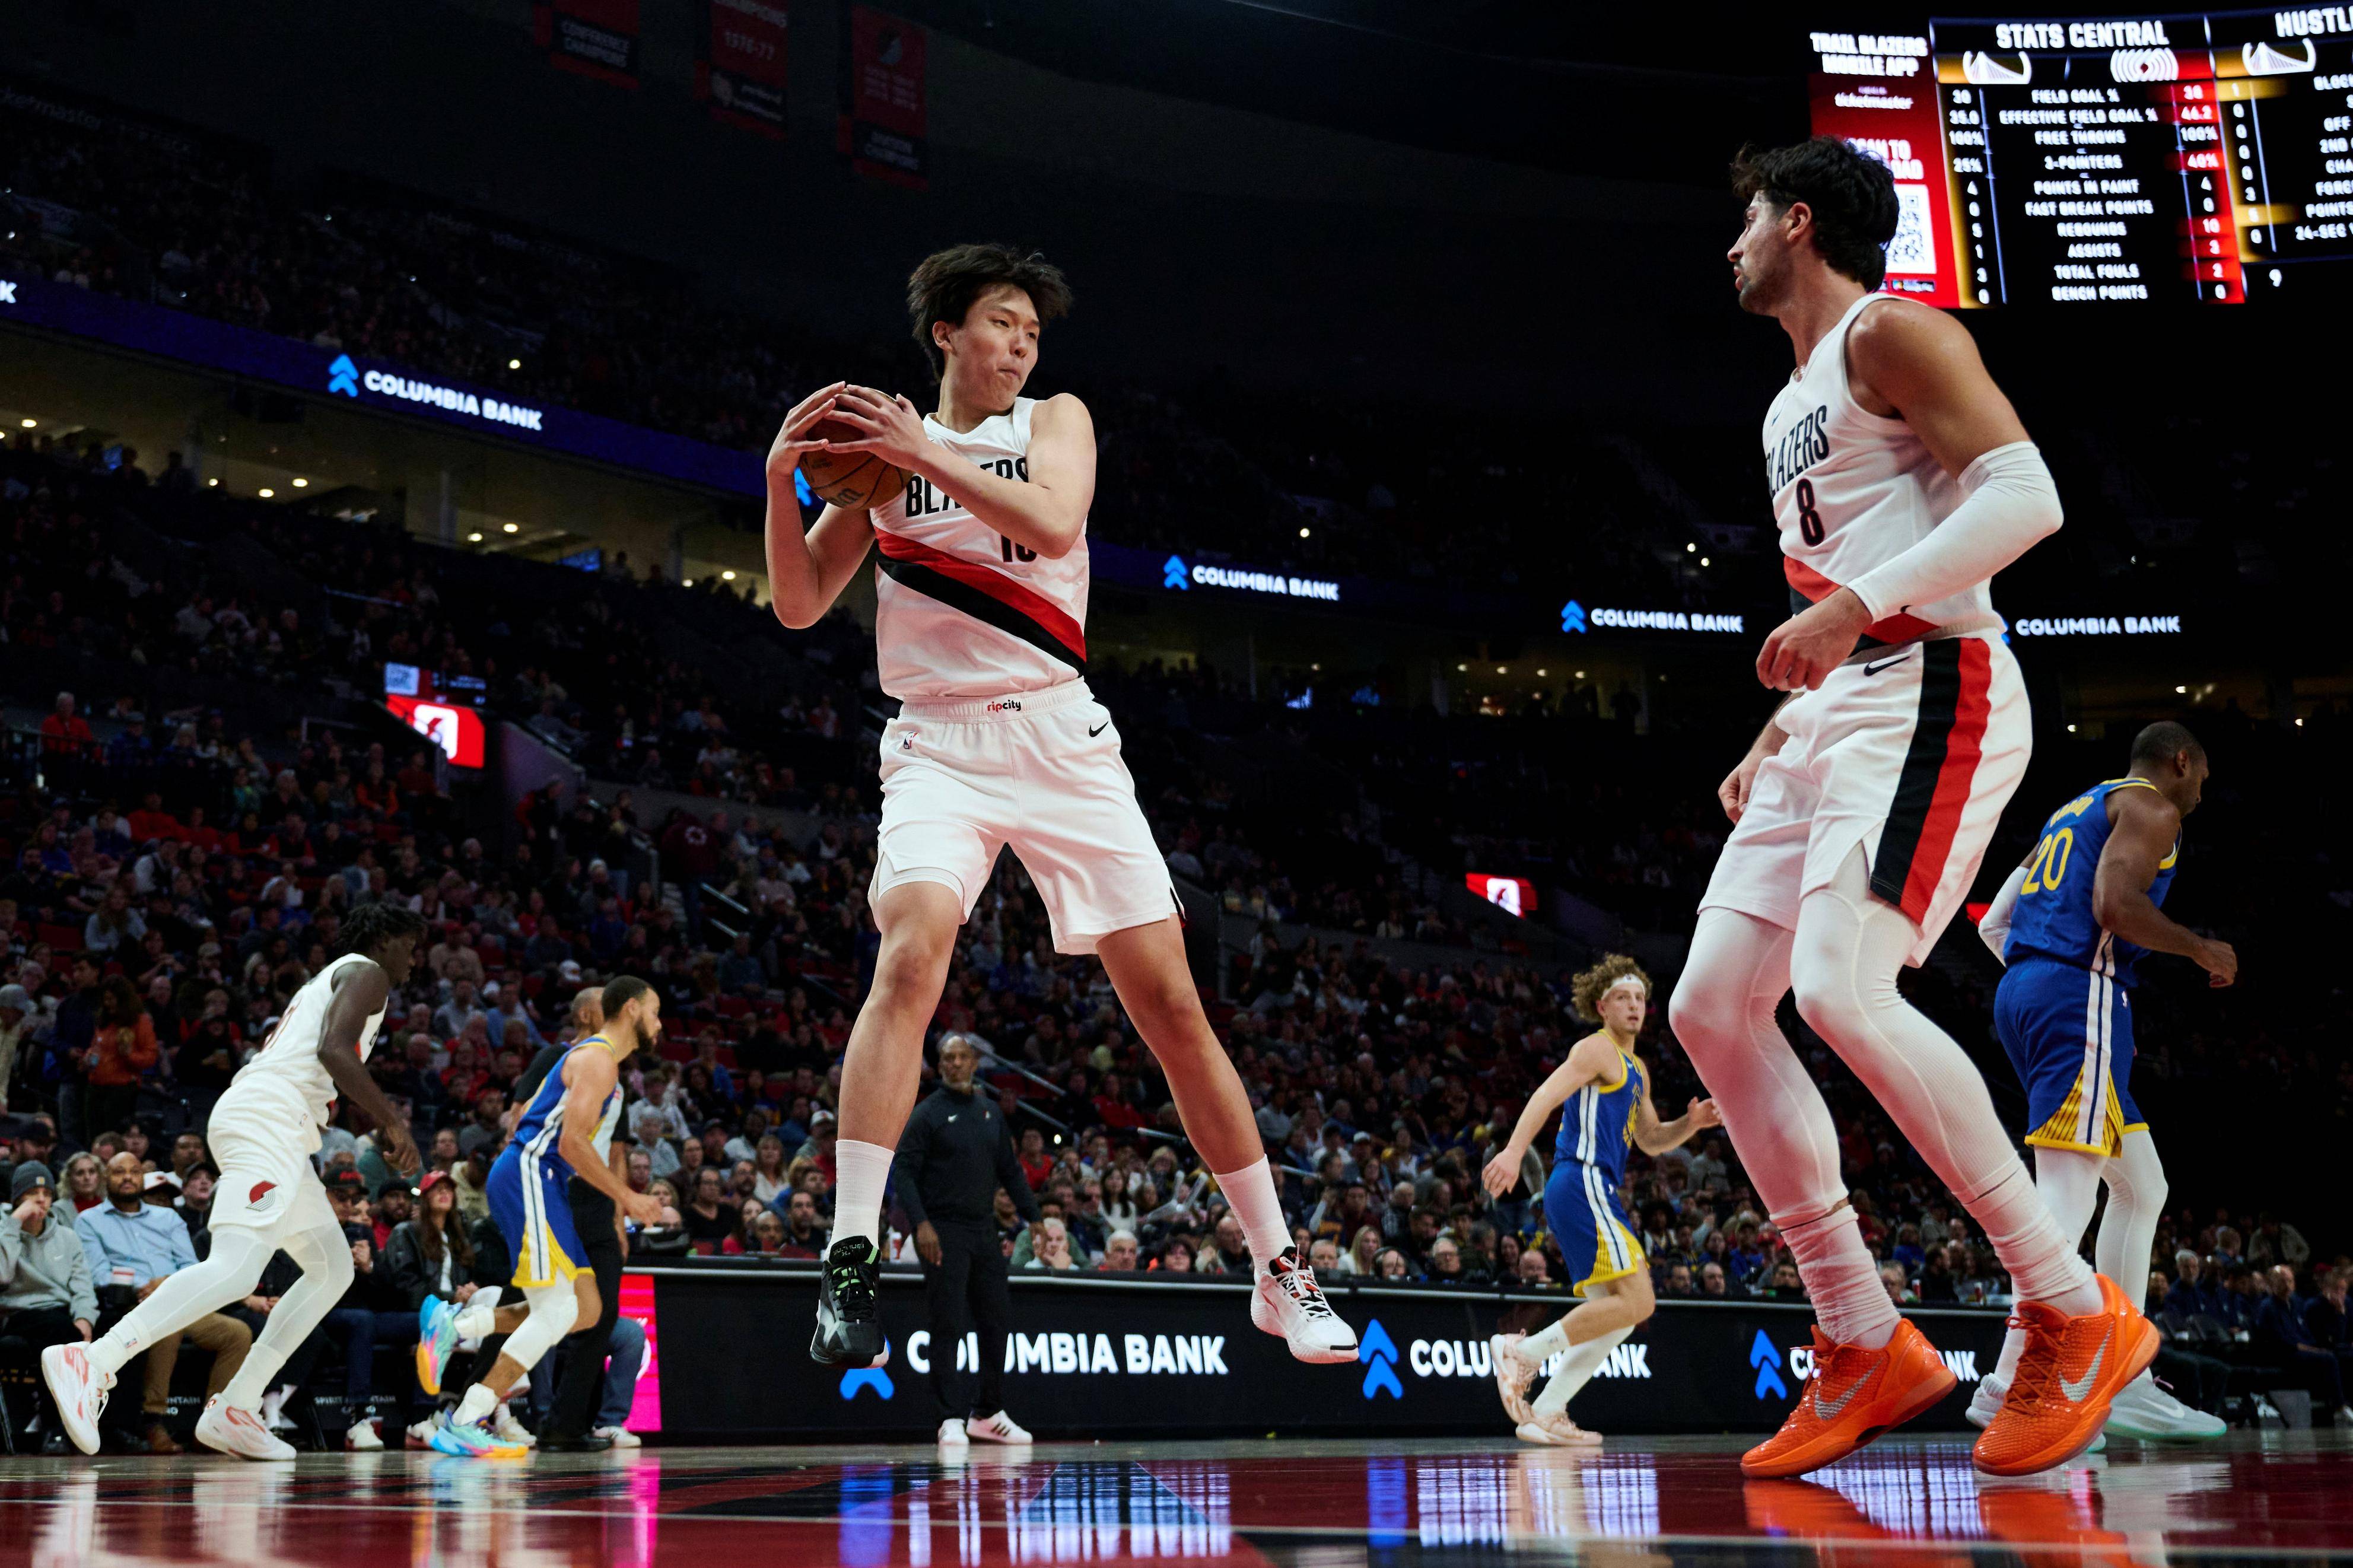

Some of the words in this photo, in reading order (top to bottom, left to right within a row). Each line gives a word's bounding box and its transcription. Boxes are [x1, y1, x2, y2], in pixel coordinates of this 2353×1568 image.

[1810, 32, 1858, 54] TRAIL
[1858, 34, 1928, 56] BLAZERS
[1996, 24, 2065, 48] STATS
[2069, 21, 2169, 48] CENTRAL
[1821, 53, 1885, 76] MOBILE
[1885, 56, 1919, 77] APP
[1834, 92, 1914, 109] ticketmaster
[1953, 90, 1971, 104] 30
[2031, 90, 2068, 103] FIELD
[2071, 89, 2106, 103] GOAL
[2107, 88, 2120, 102] %
[1950, 110, 1979, 125] 35.0
[1999, 110, 2067, 124] EFFECTIVE
[2069, 110, 2106, 123] FIELD
[2109, 109, 2144, 123] GOAL
[2233, 103, 2244, 117] 0
[1949, 131, 1985, 145] 100%
[2035, 131, 2069, 145] FREE
[2071, 129, 2126, 144] THROWS
[2180, 126, 2218, 141] 100%
[2236, 124, 2247, 138] 0
[2324, 116, 2351, 131] OFF
[1888, 139, 1911, 160] TO
[2239, 145, 2250, 159] 0
[2320, 138, 2348, 153] 2ND
[1953, 158, 1983, 172] 25%
[2044, 155, 2122, 170] 3-POINTERS
[2188, 154, 2219, 168] 40%
[2242, 166, 2253, 180] 0
[2034, 180, 2082, 195] POINTS
[2084, 180, 2098, 194] IN
[2100, 179, 2139, 193] PAINT
[1969, 202, 1980, 217] 0
[2025, 202, 2056, 216] FAST
[2059, 201, 2103, 215] BREAK
[2106, 200, 2153, 215] POINTS
[2203, 198, 2214, 212] 0
[2057, 222, 2126, 237] REBOUNDS
[2203, 218, 2220, 233] 10
[2251, 229, 2262, 244] 0
[2295, 223, 2346, 240] 24-SEC
[1975, 244, 1983, 259] 1
[2068, 243, 2121, 257] ASSISTS
[2054, 265, 2095, 279] TOTAL
[2097, 263, 2139, 278] FOULS
[2269, 269, 2282, 287] 9
[1979, 289, 1989, 304] 0
[2052, 286, 2096, 300] BENCH
[2099, 285, 2148, 300] POINTS
[2215, 285, 2225, 299] 0
[364, 370, 480, 415] COLUMBIA
[482, 399, 542, 430] BANK
[1796, 477, 1826, 548] 8
[1192, 565, 1287, 594] COLUMBIA
[1289, 578, 1338, 600] BANK
[1591, 609, 1689, 630] COLUMBIA
[1690, 613, 1742, 632] BANK
[2015, 617, 2120, 636] COLUMBIA
[2124, 616, 2181, 634] BANK
[987, 699, 1021, 713] ripcity
[2020, 827, 2073, 895] 20
[1124, 1334, 1229, 1375] BANK
